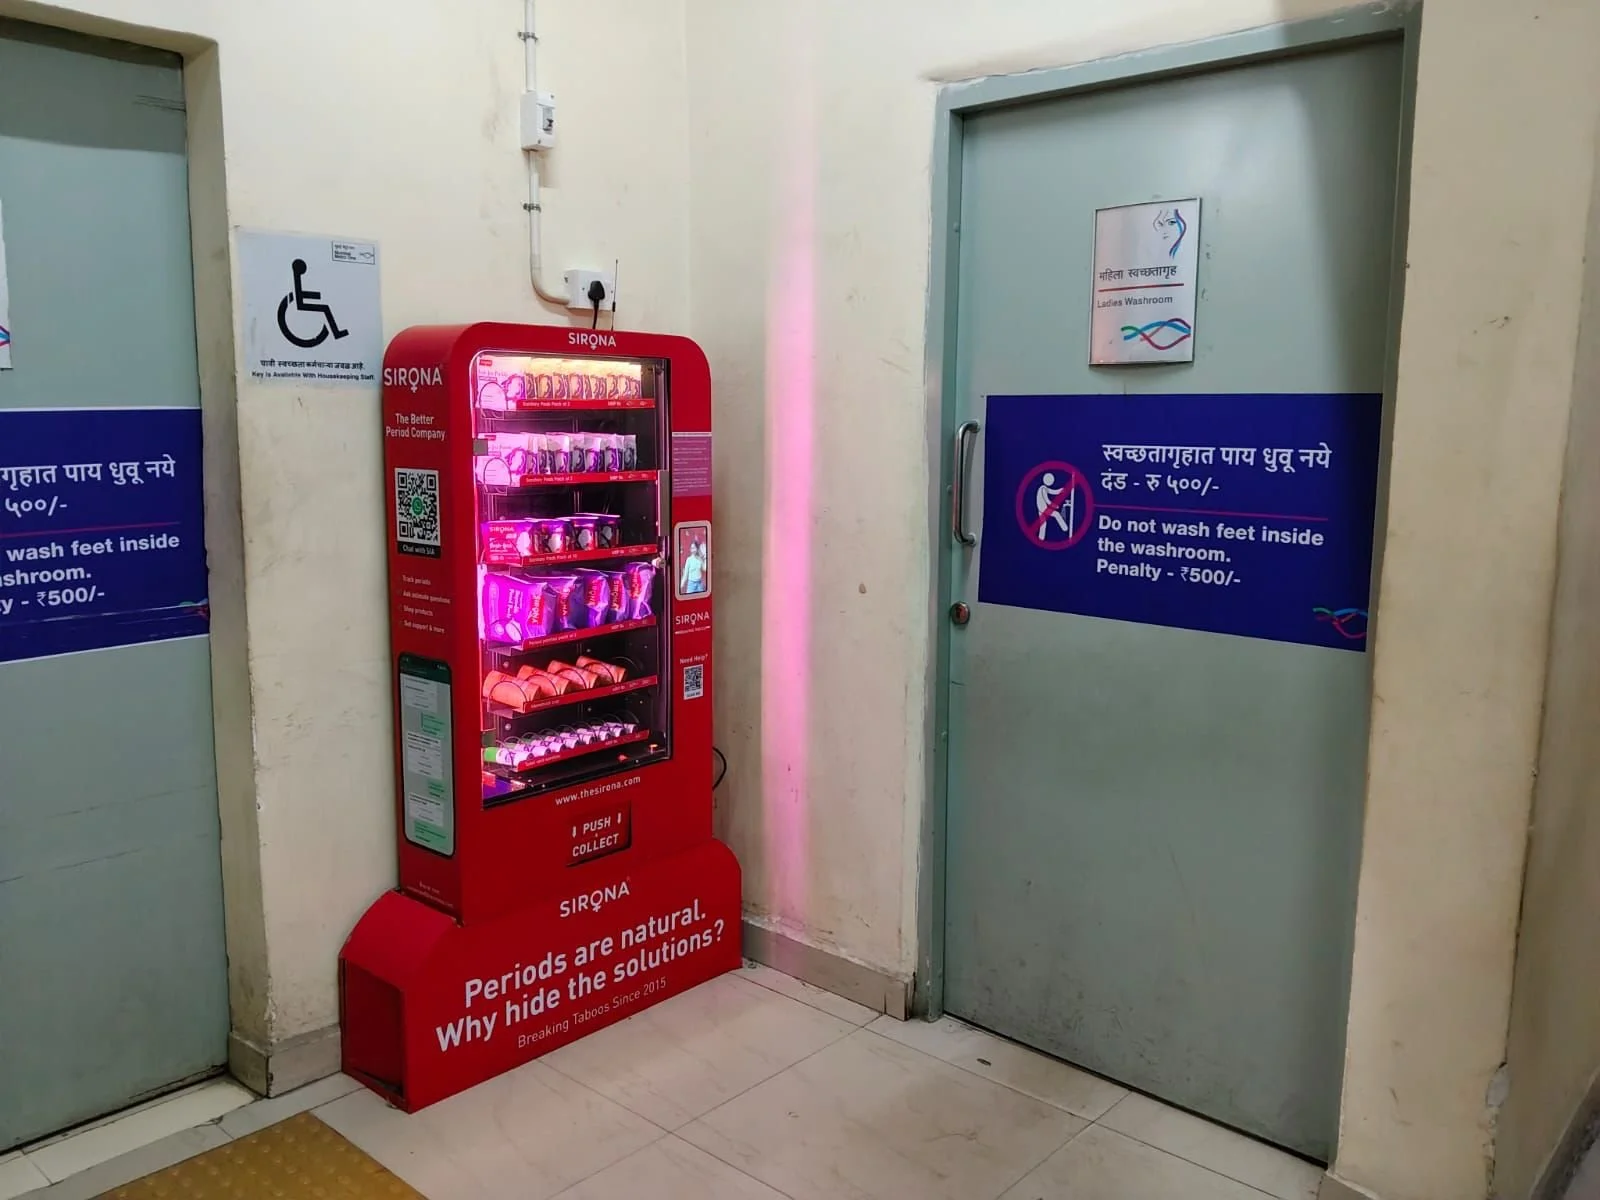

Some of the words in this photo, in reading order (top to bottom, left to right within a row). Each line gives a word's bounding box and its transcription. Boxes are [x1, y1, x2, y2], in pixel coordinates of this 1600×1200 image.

[1099, 268, 1124, 282] महिला
[1128, 265, 1178, 280] स्वच्छतागृह
[1097, 298, 1122, 308] Ladies
[1124, 296, 1173, 306] Washroom
[568, 332, 617, 350] SIRONA
[384, 366, 443, 394] SIRONA
[395, 413, 409, 424] The
[411, 413, 435, 425] Better
[386, 426, 409, 437] Period
[411, 427, 445, 441] Company
[1101, 444, 1216, 468] स्वच्छतागृहात
[1219, 446, 1257, 467] पाय
[1263, 447, 1296, 472] धुवू
[1299, 441, 1332, 468] नये
[0, 464, 58, 490] गृहात
[63, 463, 102, 482] पाय
[109, 460, 144, 486] धुवू
[144, 454, 176, 478] नये
[1101, 467, 1128, 492] दंड
[1146, 473, 1162, 492] रु
[1166, 476, 1220, 497] ५००/-
[1098, 514, 1121, 531] Do
[1127, 520, 1157, 535] not
[1162, 519, 1210, 539] wash
[1216, 522, 1256, 542] feet
[1262, 525, 1325, 547] inside
[6, 542, 64, 562] wash
[71, 537, 114, 556] feet
[119, 533, 180, 553] inside
[1098, 537, 1125, 554] the
[1130, 541, 1232, 563] washroom.
[1096, 559, 1162, 582] Penalty
[1180, 566, 1241, 587] ₹500/-
[36, 586, 105, 606] ₹500/-
[675, 611, 710, 625] SIRONA
[555, 775, 641, 806] www.thesirona.com
[582, 816, 612, 835] PUSH
[572, 833, 620, 857] COLLECT
[559, 881, 630, 918] SIRONA
[465, 952, 567, 1008] Periods
[574, 934, 613, 967] are
[621, 898, 706, 949] natural.
[436, 1011, 497, 1052] Why
[505, 988, 560, 1026] hide
[568, 972, 606, 1000] the
[614, 920, 724, 983] solutions?
[518, 1020, 569, 1048] Breaking
[573, 1004, 610, 1024] Taboos
[612, 989, 640, 1012] Since
[643, 977, 666, 997] 2015
